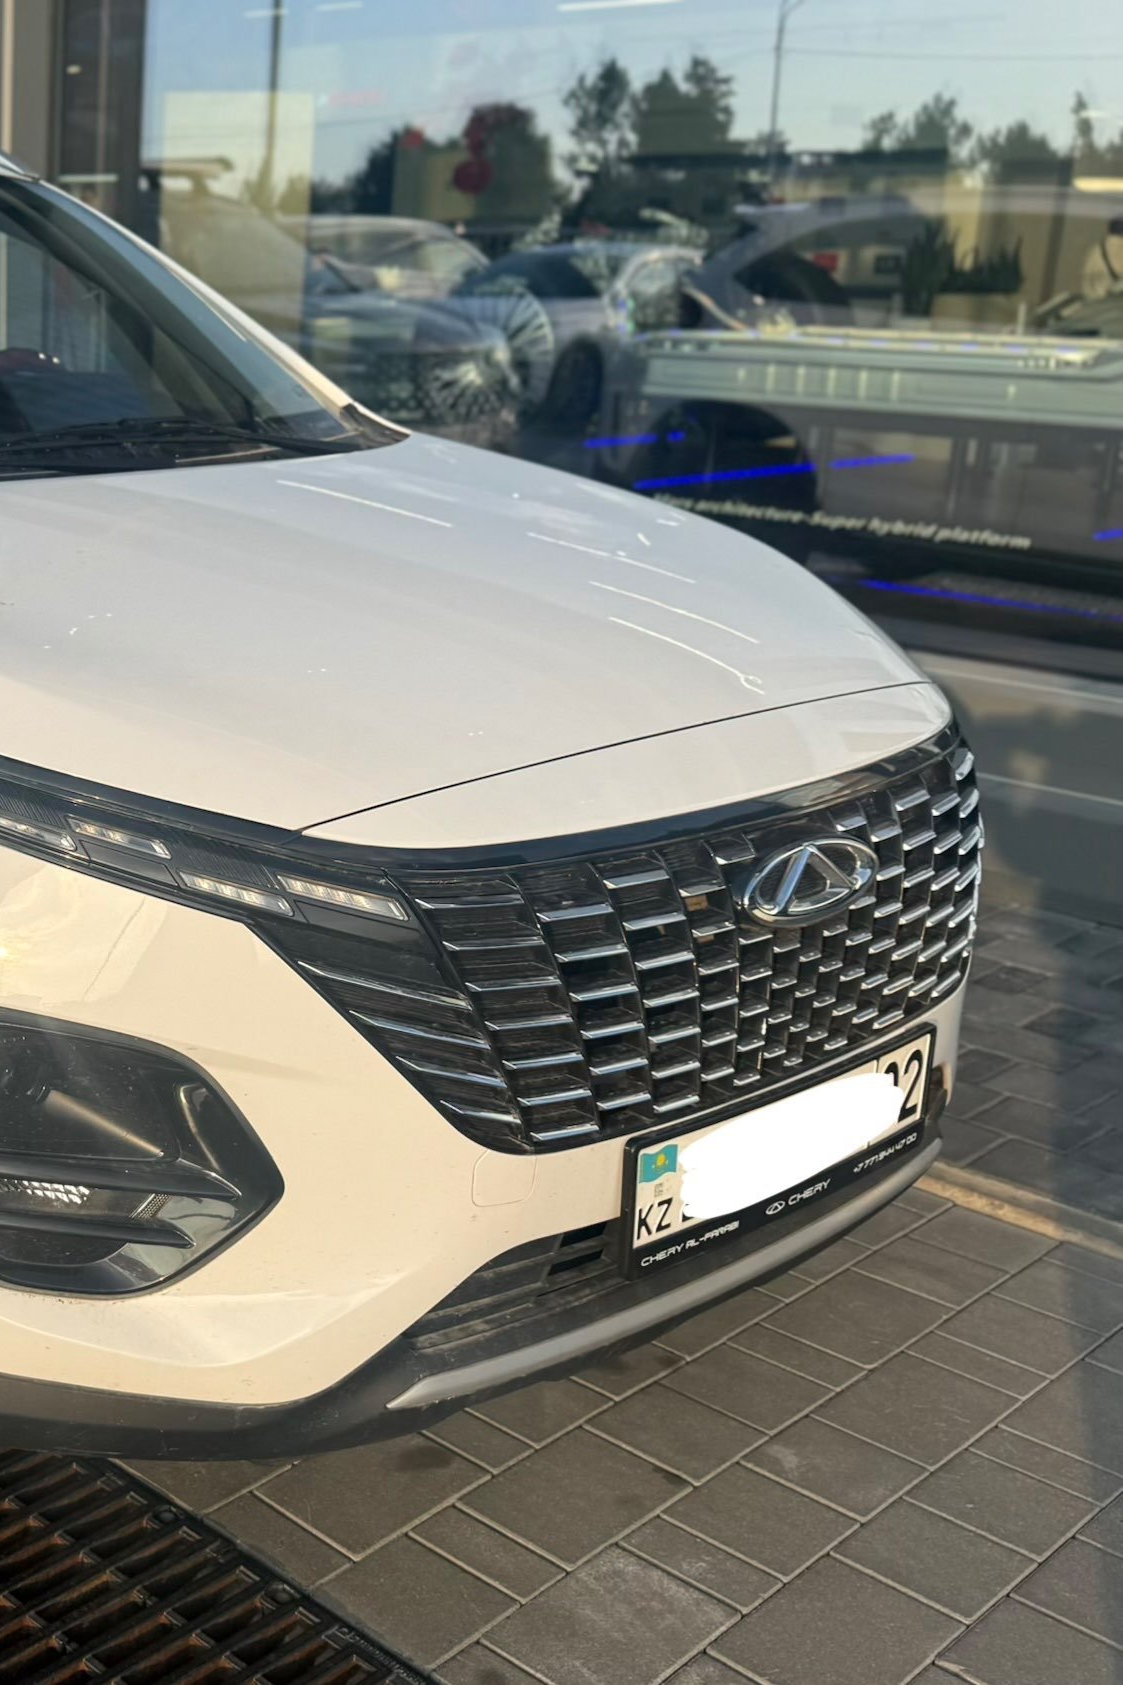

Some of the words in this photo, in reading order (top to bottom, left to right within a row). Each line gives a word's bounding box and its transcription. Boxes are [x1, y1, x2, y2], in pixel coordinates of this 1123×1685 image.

[867, 516, 938, 536] hybrid
[934, 525, 1032, 550] platform
[788, 1179, 831, 1205] CHERY
[636, 1197, 674, 1241] KZ
[641, 1243, 684, 1267] CHERY
[685, 1220, 740, 1249] AL-FARABI
